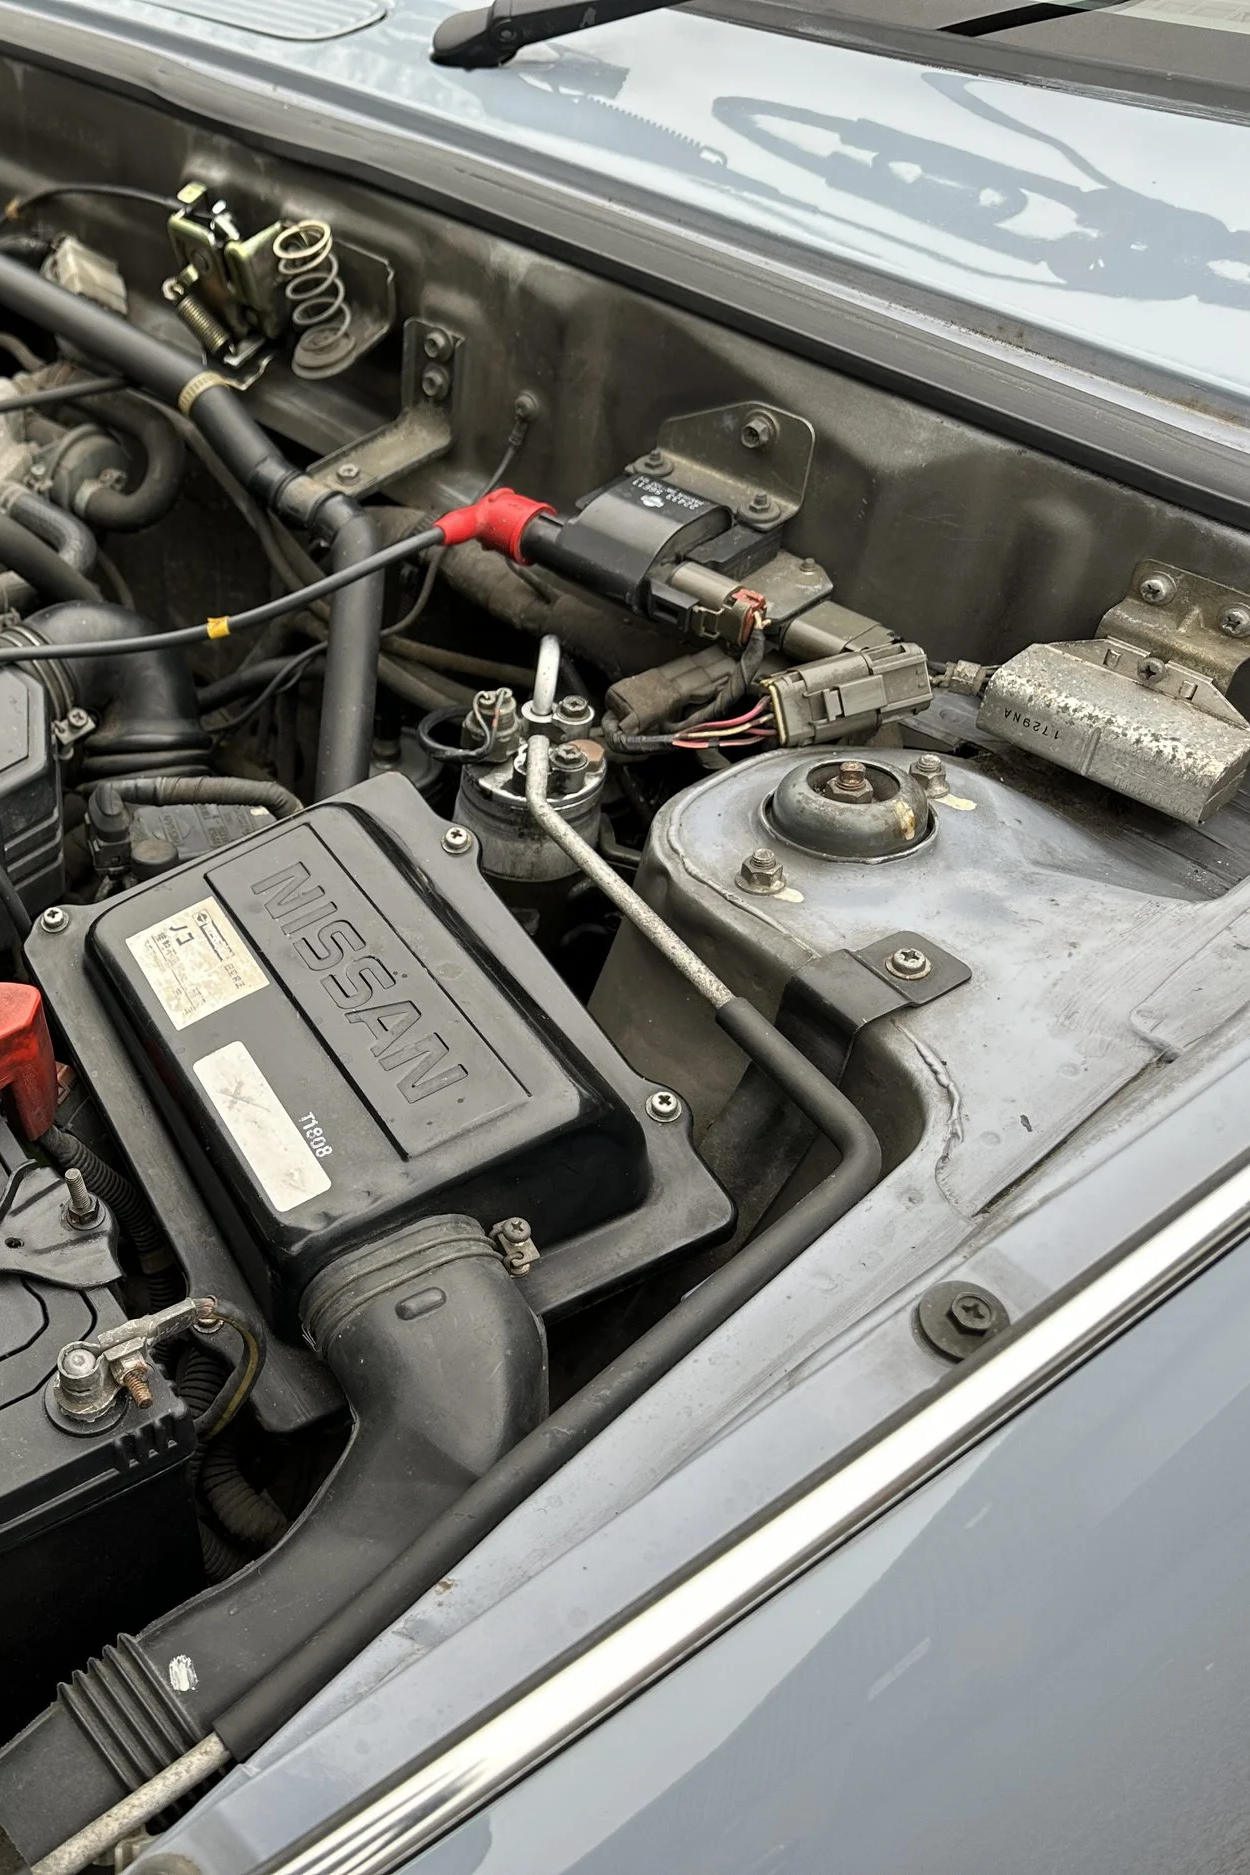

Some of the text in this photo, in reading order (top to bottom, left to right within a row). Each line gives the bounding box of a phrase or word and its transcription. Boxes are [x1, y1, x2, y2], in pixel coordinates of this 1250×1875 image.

[1004, 707, 1059, 740] 1729NA
[250, 861, 469, 1104] NISSAN
[299, 1111, 333, 1158] T1808
